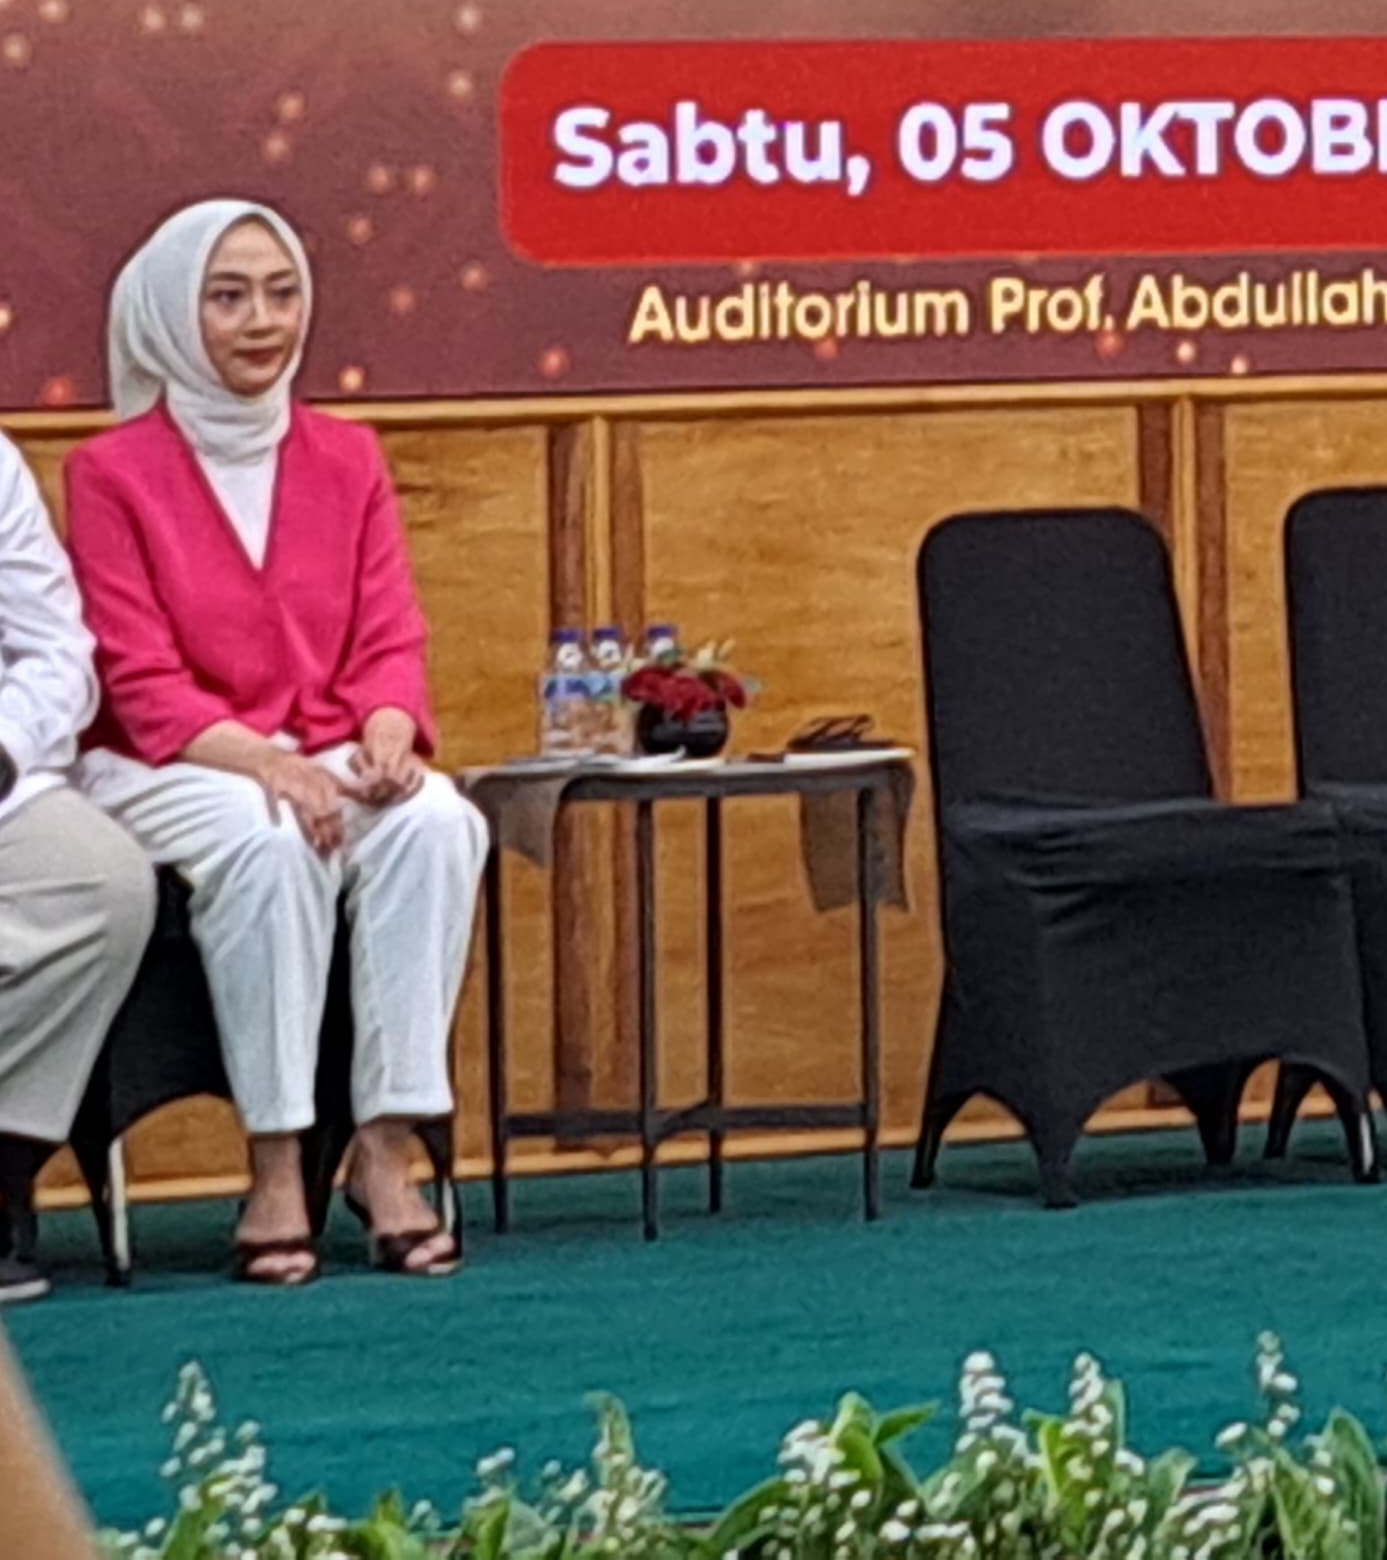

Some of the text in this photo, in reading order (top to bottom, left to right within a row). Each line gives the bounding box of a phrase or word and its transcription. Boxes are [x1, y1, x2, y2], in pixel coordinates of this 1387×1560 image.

[552, 101, 870, 196] Sabtu,
[898, 103, 1014, 181] 05
[628, 281, 970, 344] Auditorium
[991, 274, 1114, 334] Prof.
